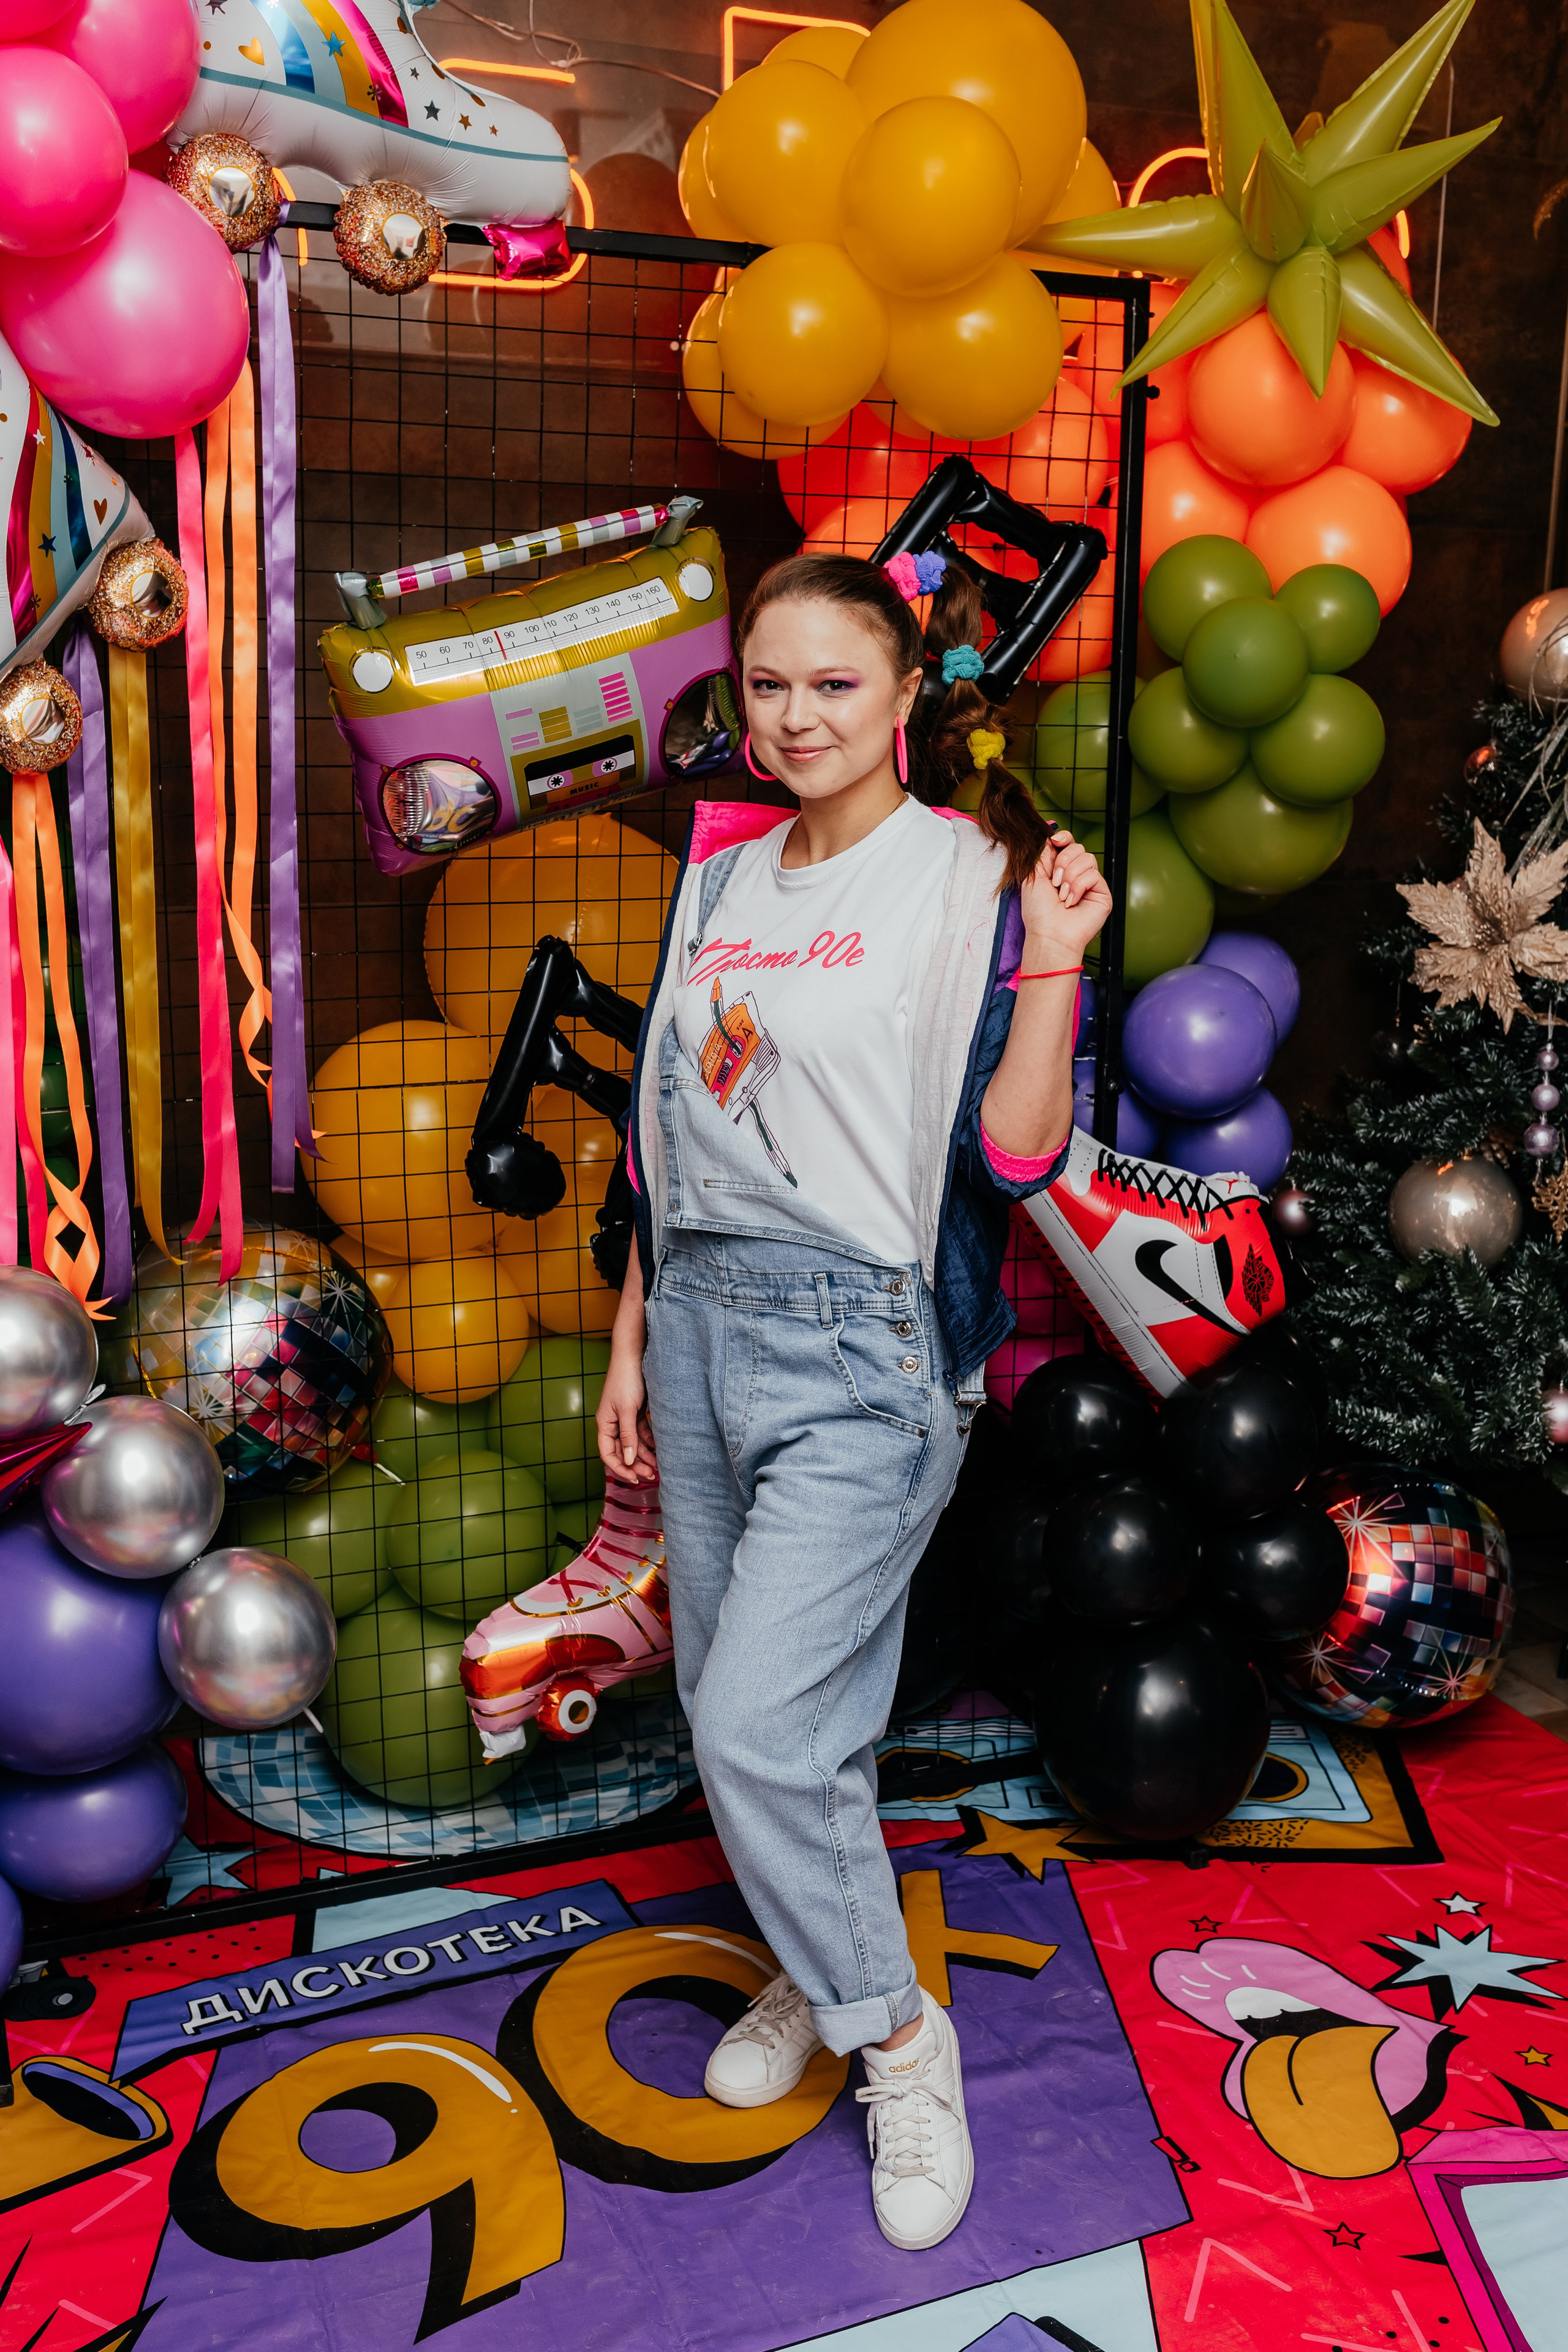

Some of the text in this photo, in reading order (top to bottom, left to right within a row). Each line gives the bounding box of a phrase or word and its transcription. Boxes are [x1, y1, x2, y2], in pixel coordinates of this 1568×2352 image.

[415, 585, 661, 660] 50 60 70 80 90 100 110 120 130 140 150 160
[570, 781, 599, 795] MUSIC
[736, 1019, 745, 1031] SIDE
[741, 1027, 753, 1044] A
[182, 1905, 601, 2035] ДИСКОТЕКА
